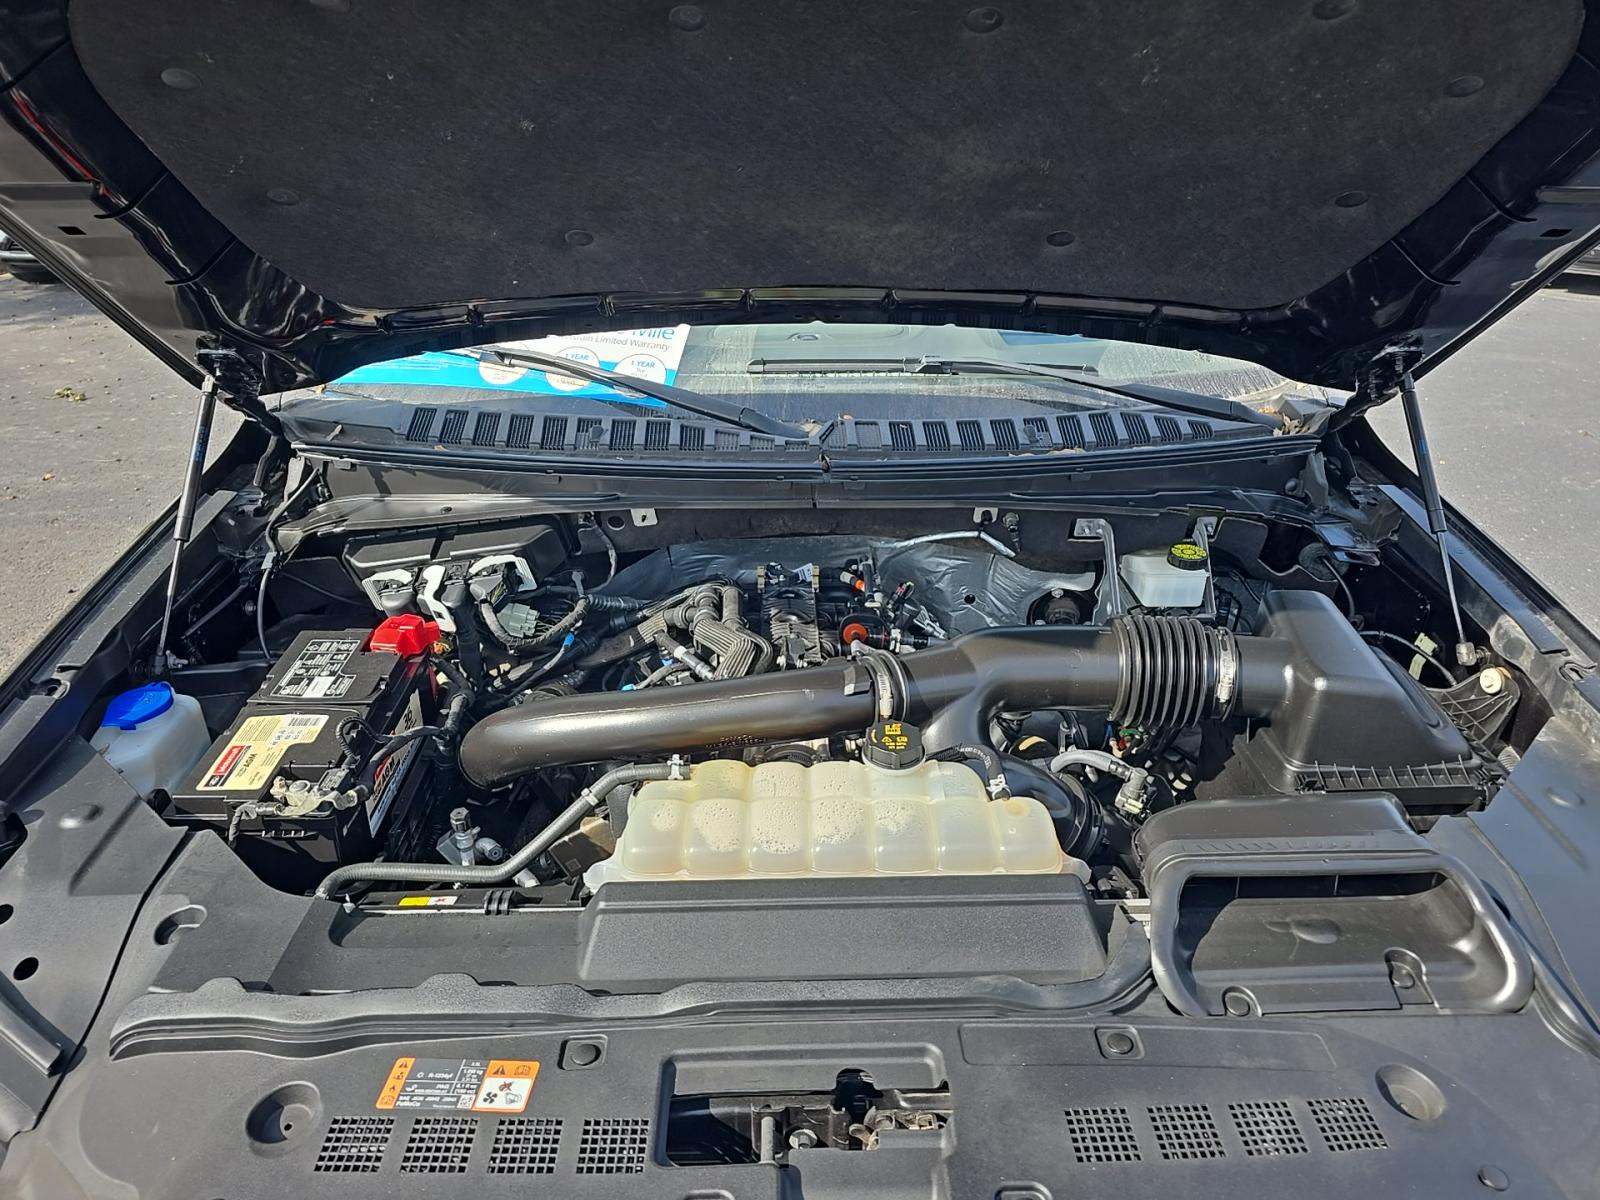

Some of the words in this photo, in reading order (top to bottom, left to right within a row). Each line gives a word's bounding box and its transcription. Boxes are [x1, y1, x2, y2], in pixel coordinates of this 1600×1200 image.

[595, 335, 628, 346] Limited
[630, 339, 670, 353] Warranty
[636, 360, 656, 368] YEAR
